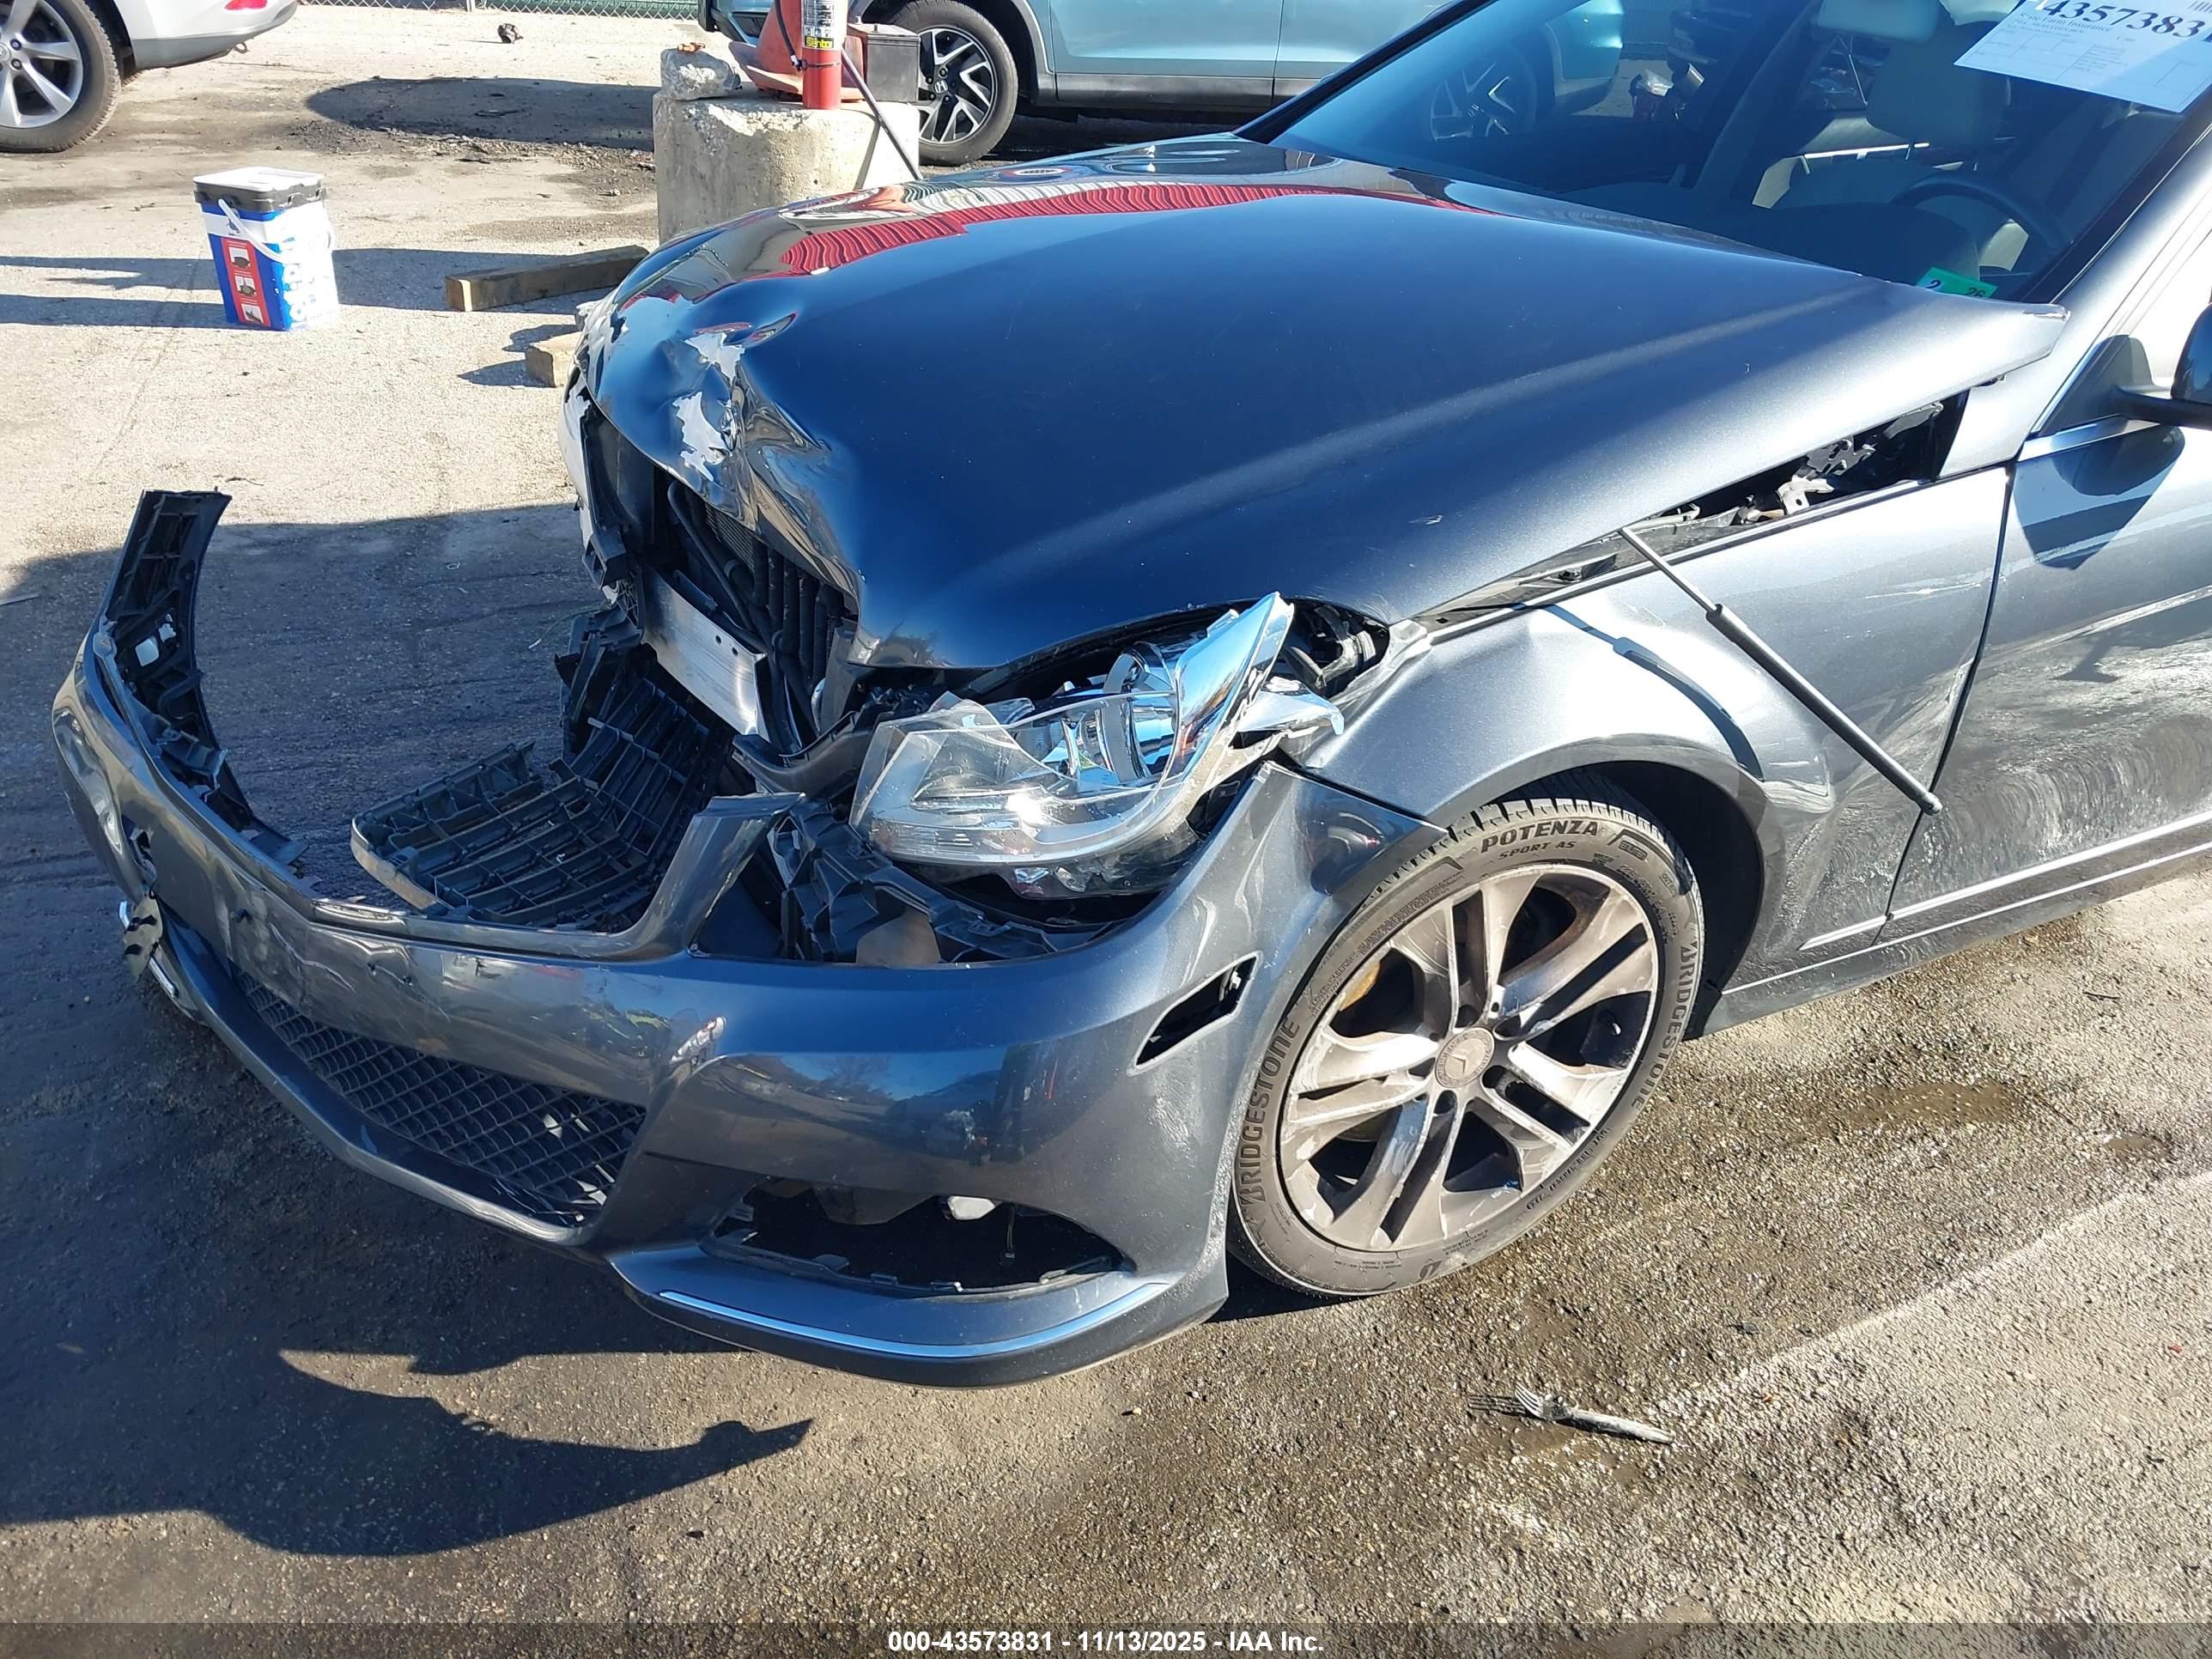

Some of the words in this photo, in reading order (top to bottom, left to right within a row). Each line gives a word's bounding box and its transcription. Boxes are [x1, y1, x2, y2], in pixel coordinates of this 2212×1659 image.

[1925, 279, 1942, 289] 2
[1964, 287, 1986, 298] 26
[1480, 820, 1599, 853] POTENZA
[1498, 842, 1552, 860] SPORT
[1555, 841, 1577, 849] AS
[1631, 939, 1698, 1112] BRIDGESTONE
[1237, 1018, 1300, 1206] BRIDGESTONE
